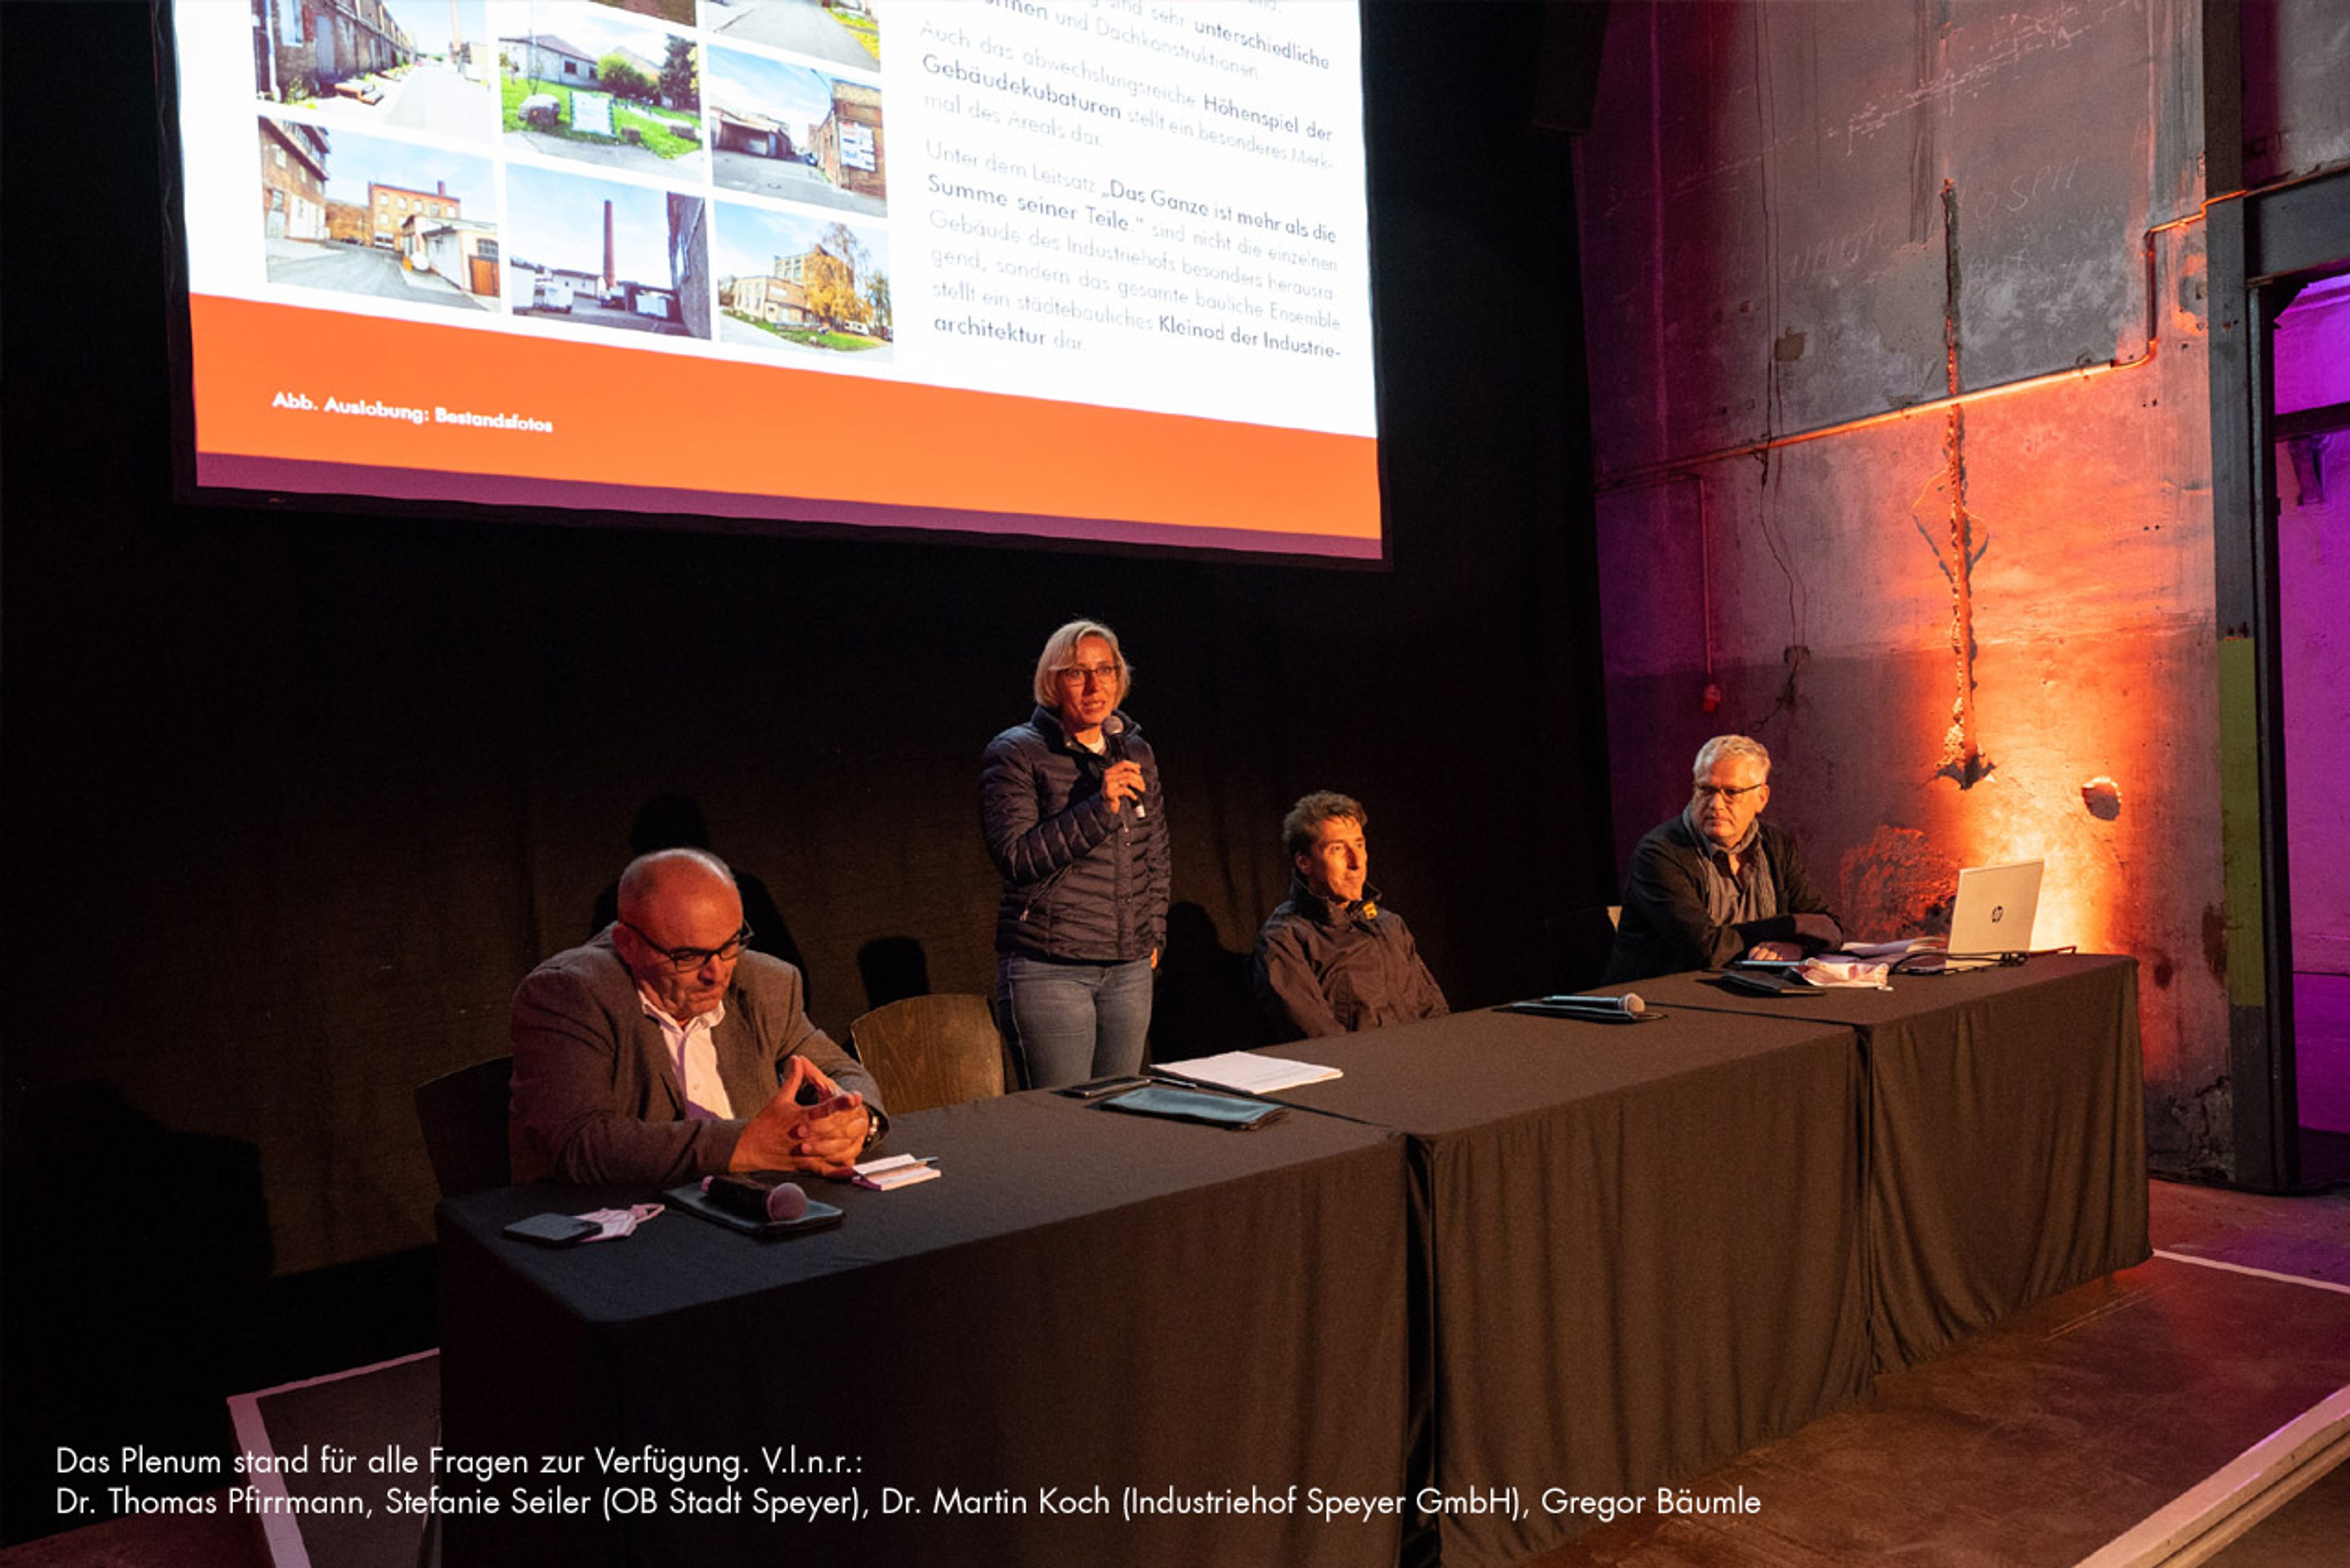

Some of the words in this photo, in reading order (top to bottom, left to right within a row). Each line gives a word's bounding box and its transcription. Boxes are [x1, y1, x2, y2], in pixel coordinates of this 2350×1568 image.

[1055, 10, 1088, 31] und
[1151, 6, 1185, 27] sehr
[1195, 20, 1329, 70] unterschiedliche
[920, 20, 970, 48] Auch
[980, 34, 1013, 60] das
[1023, 47, 1196, 106] abwechslungsreiche
[1204, 93, 1299, 134] Höhenspiel
[1306, 121, 1333, 141] der
[922, 53, 1121, 119] Gebäudekubaturen
[1127, 109, 1164, 130] stellt
[1169, 120, 1193, 138] ein
[1199, 121, 1286, 160] besonderes
[924, 94, 960, 113] mal
[969, 99, 1001, 124] des
[1008, 110, 1065, 140] Areals
[926, 139, 978, 166] Unter
[985, 154, 1026, 178] dem
[1033, 163, 1095, 192] Leitsatz
[1151, 189, 1209, 217] Ganze
[1214, 201, 1232, 222] ist
[1237, 211, 1281, 232] mehr
[1285, 218, 1308, 238] als
[1313, 223, 1337, 243] die
[928, 173, 1008, 207] Summe
[1018, 196, 1078, 221] seiner
[1152, 222, 1185, 243] sind
[1193, 230, 1231, 251] nicht
[1237, 237, 1263, 258] die
[1268, 246, 1338, 272] einzelnen
[930, 208, 1020, 243] Gebäude
[1029, 228, 1060, 250] des
[1068, 236, 1175, 272] Industriehofs
[1182, 256, 1263, 287] besonders
[931, 248, 987, 272] gend,
[996, 261, 1070, 285] sondern
[1079, 269, 1110, 292] das
[1117, 280, 1189, 304] gesamte
[1195, 288, 1263, 317] bauliche
[1270, 302, 1340, 330] Ensemble
[933, 281, 975, 302] stellt
[983, 289, 1010, 308] ein
[1018, 296, 1153, 330] städtebauliches
[1159, 315, 1225, 341] Kleinod
[1231, 326, 1258, 345] der
[1264, 332, 1341, 358] Industrie-
[934, 316, 1046, 345] architektur
[272, 392, 318, 411] Abb.
[324, 397, 429, 424] Auslobung:
[435, 406, 553, 433] Bestandsfotos
